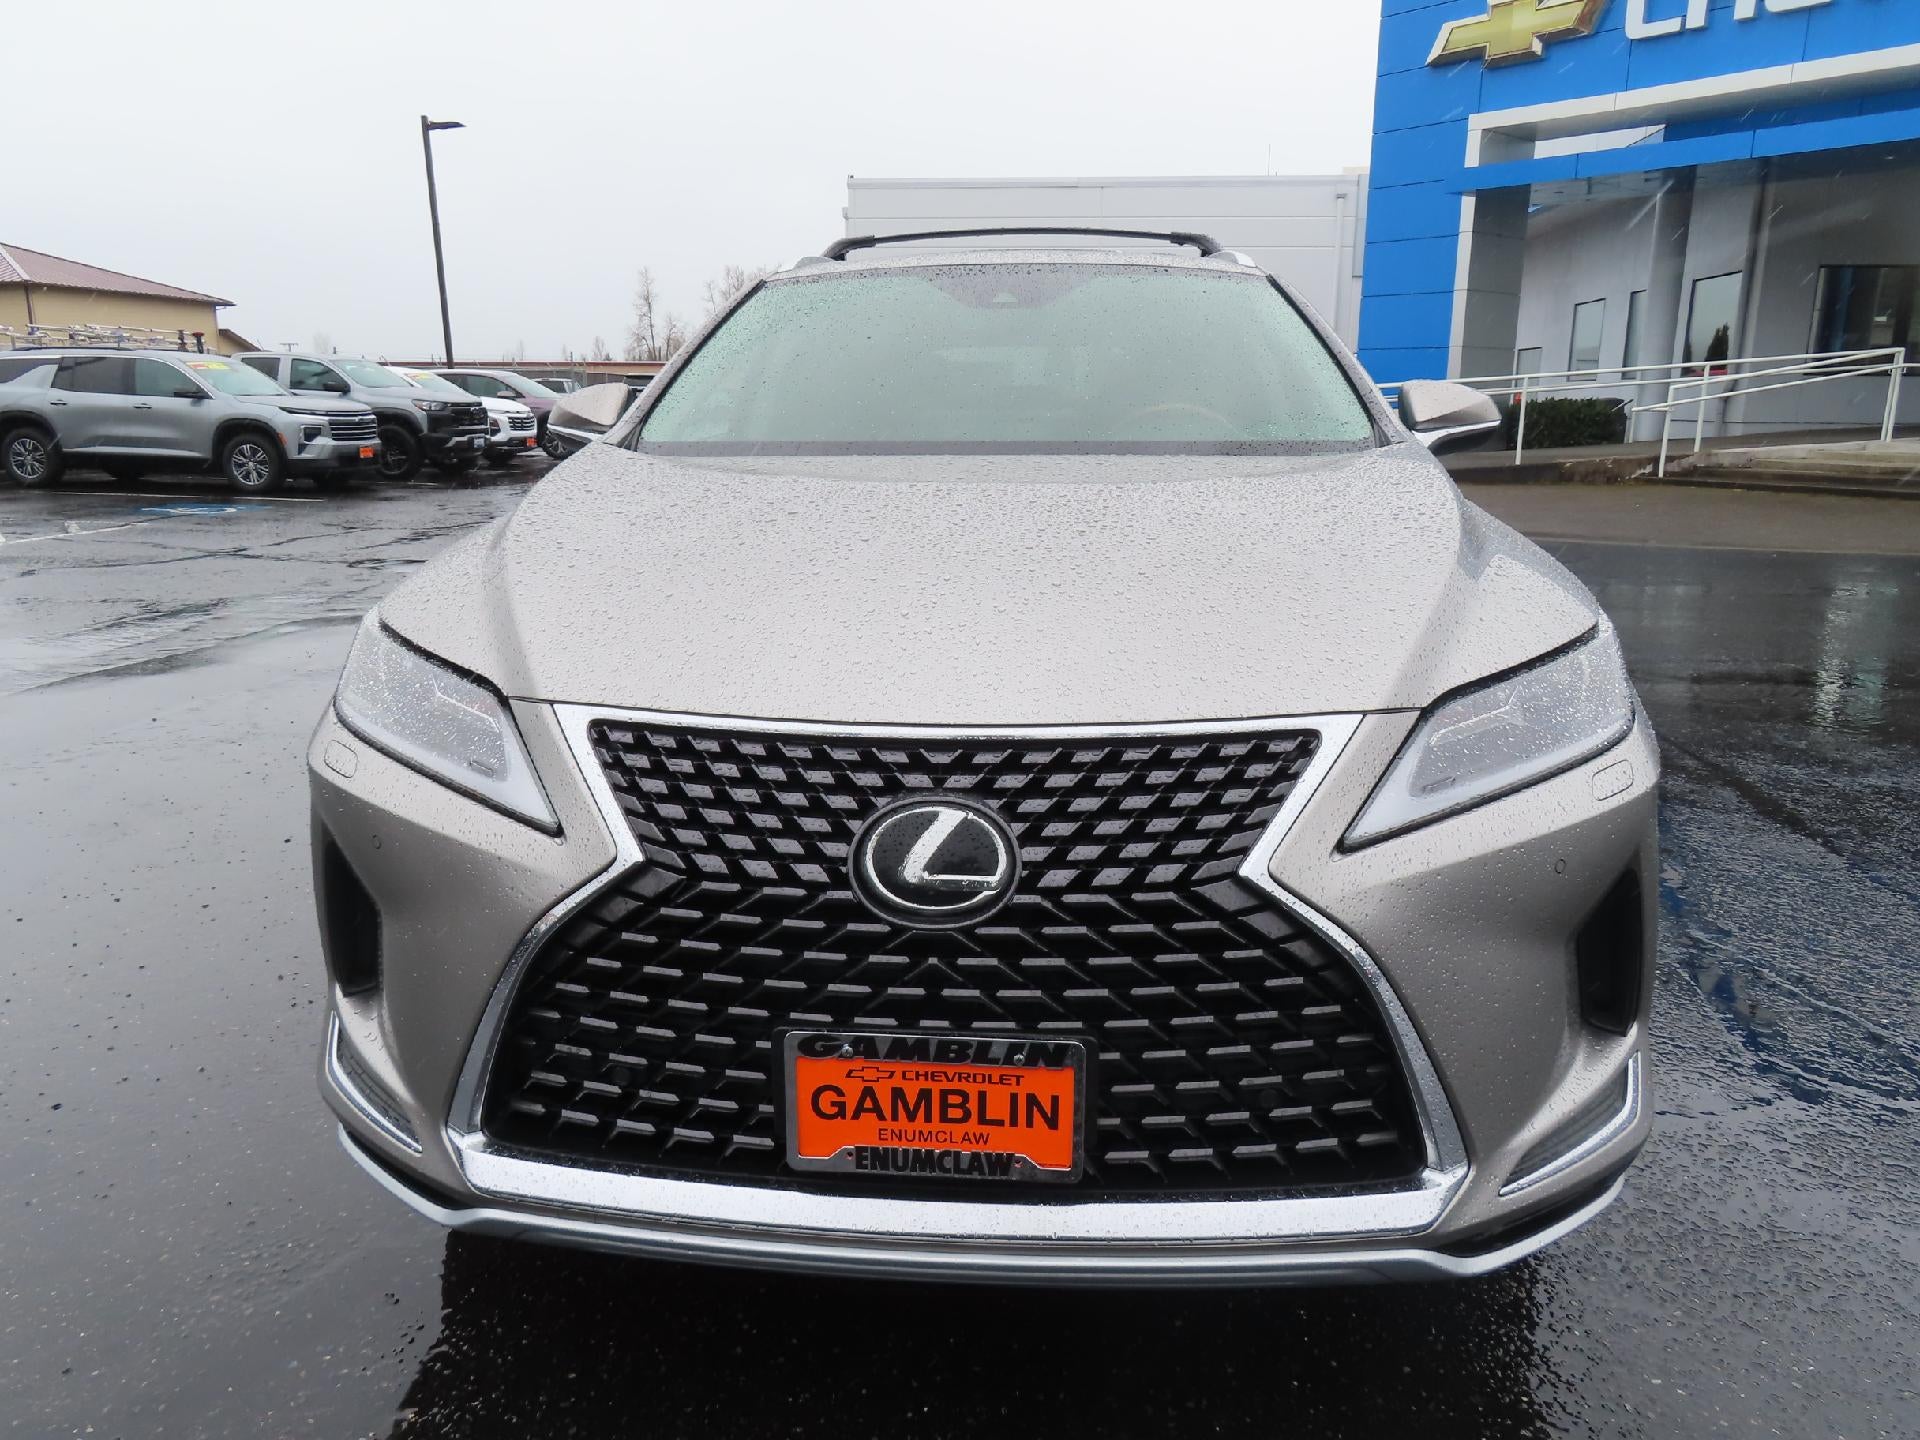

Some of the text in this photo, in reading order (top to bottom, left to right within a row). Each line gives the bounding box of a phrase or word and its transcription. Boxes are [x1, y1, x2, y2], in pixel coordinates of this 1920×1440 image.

[797, 1034, 1071, 1068] GAMBLIN
[901, 1069, 1025, 1087] CHEVROLET
[810, 1084, 1060, 1131] GAMBLIN
[878, 1127, 990, 1146] ENUMCLAW
[855, 1145, 1015, 1177] ENUMCLAW
